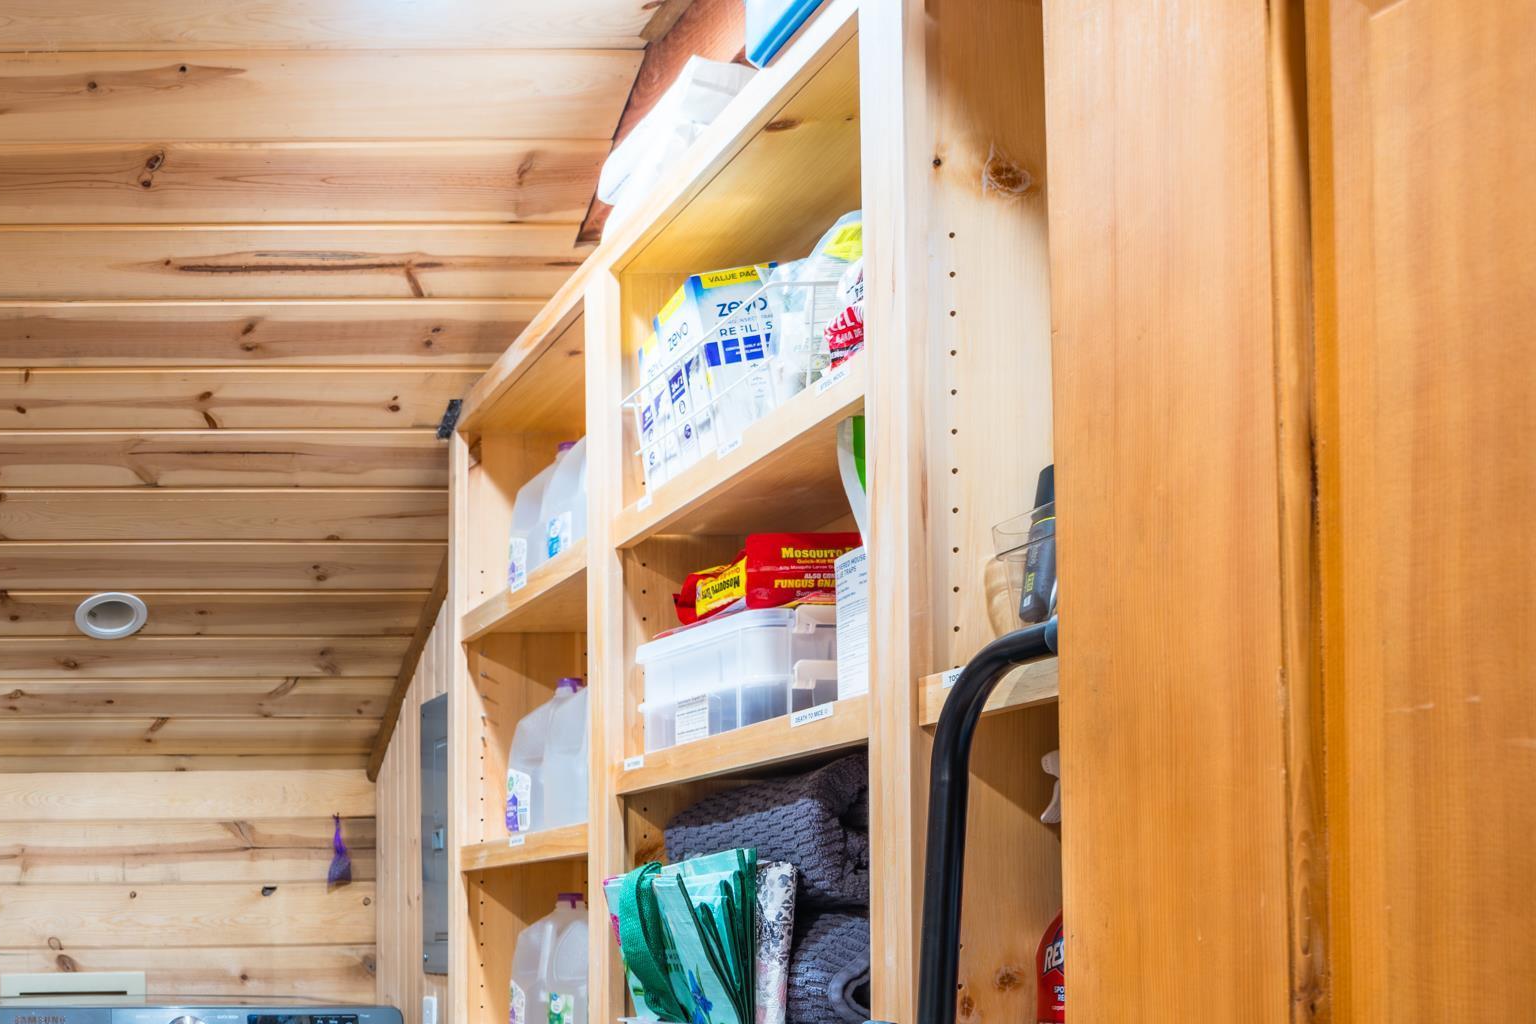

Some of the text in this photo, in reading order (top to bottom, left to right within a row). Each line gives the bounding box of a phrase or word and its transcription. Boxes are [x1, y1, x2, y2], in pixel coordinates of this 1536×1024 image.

[708, 270, 757, 283] VALUE PAC
[774, 579, 814, 588] FUNGUS
[794, 710, 824, 723] DEATH TO MICE
[15, 1015, 66, 1024] SAMSUNG
